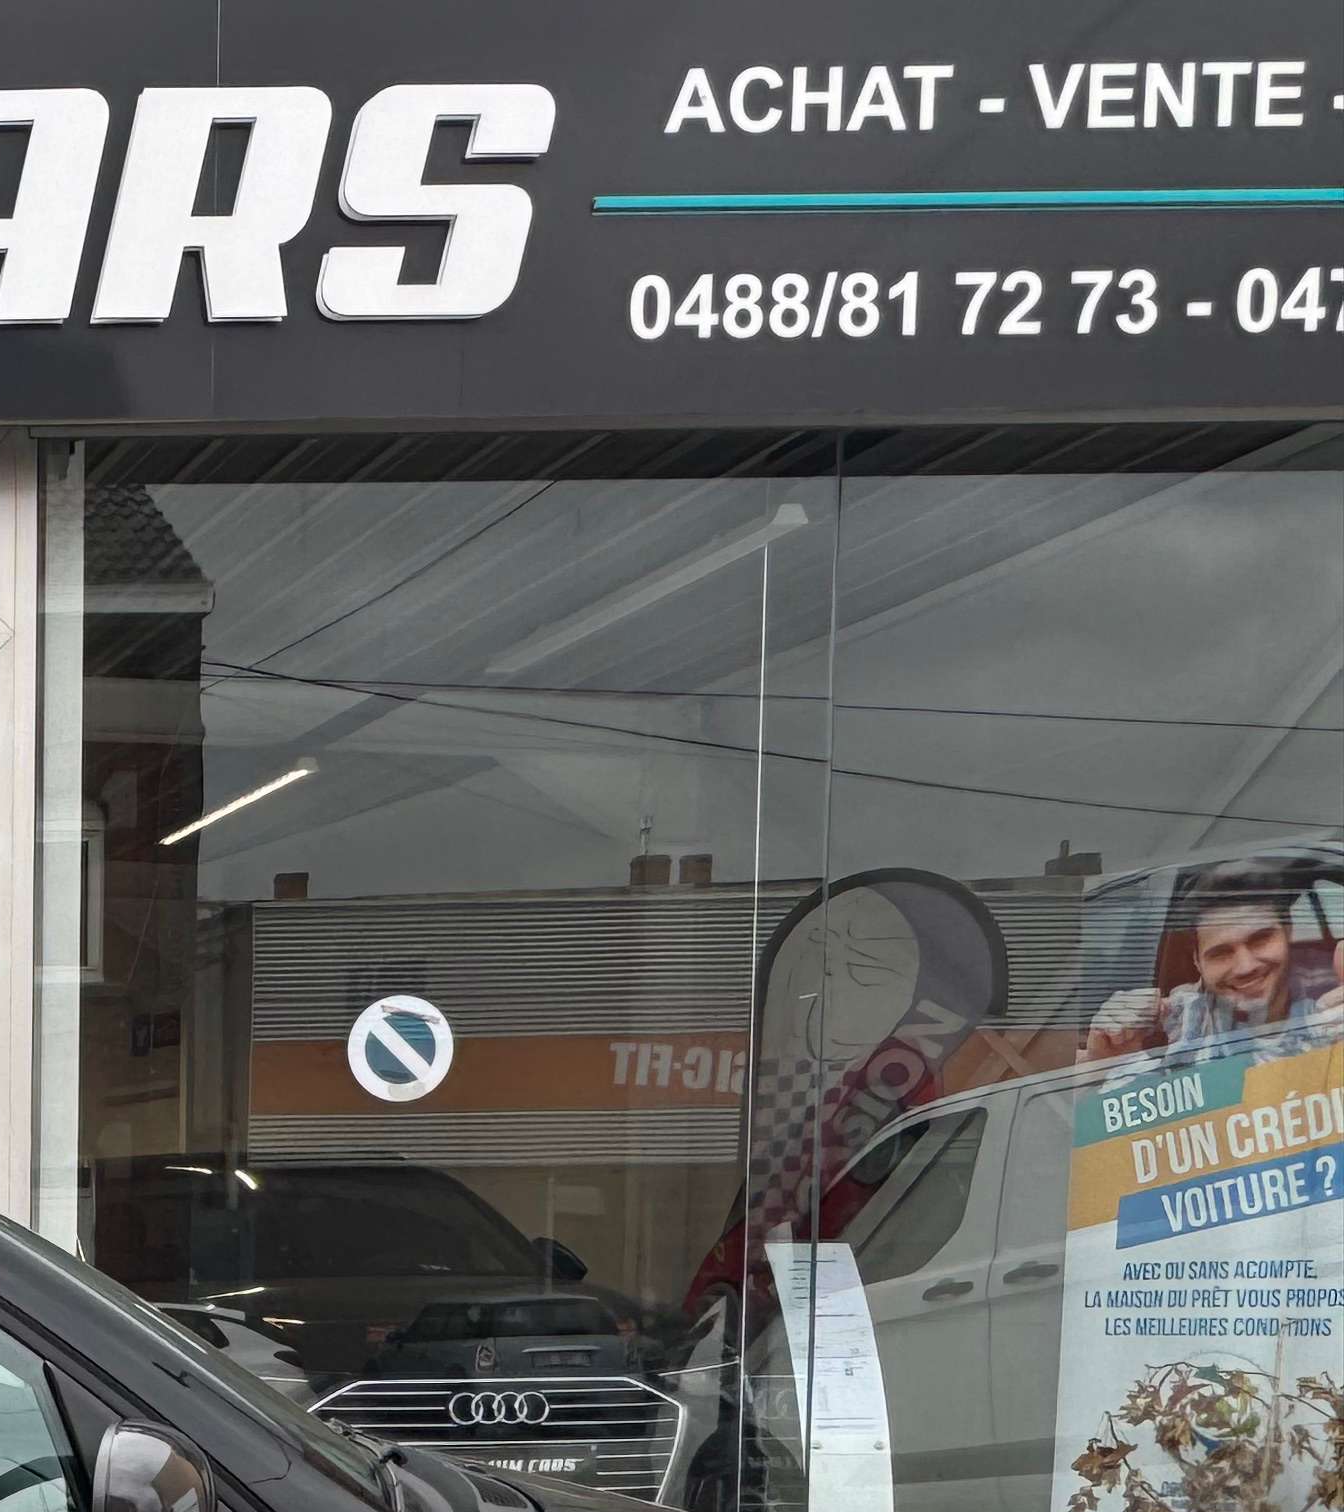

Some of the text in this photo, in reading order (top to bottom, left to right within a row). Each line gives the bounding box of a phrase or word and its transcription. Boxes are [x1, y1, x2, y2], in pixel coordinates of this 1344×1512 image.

[664, 64, 954, 133] ACHAT
[1029, 61, 1306, 128] VENTE
[629, 271, 918, 340] 0488/81
[955, 270, 1043, 336] 72
[1071, 269, 1159, 335] 73
[1102, 1072, 1205, 1133] BESOIN
[1131, 1120, 1220, 1184] D'UN
[1161, 1155, 1337, 1233] VOITURE ?
[1084, 1290, 1102, 1308] LA
[1106, 1290, 1163, 1308] MAISON
[1167, 1290, 1188, 1308] DU
[1191, 1286, 1232, 1308] PRÊT
[1236, 1289, 1281, 1308] VOUS
[1123, 1261, 1161, 1281] AVEC
[1165, 1261, 1185, 1280] OU
[1188, 1260, 1229, 1280] SANS
[1105, 1317, 1333, 1337] LES MEILLEURES CONDTIONS
